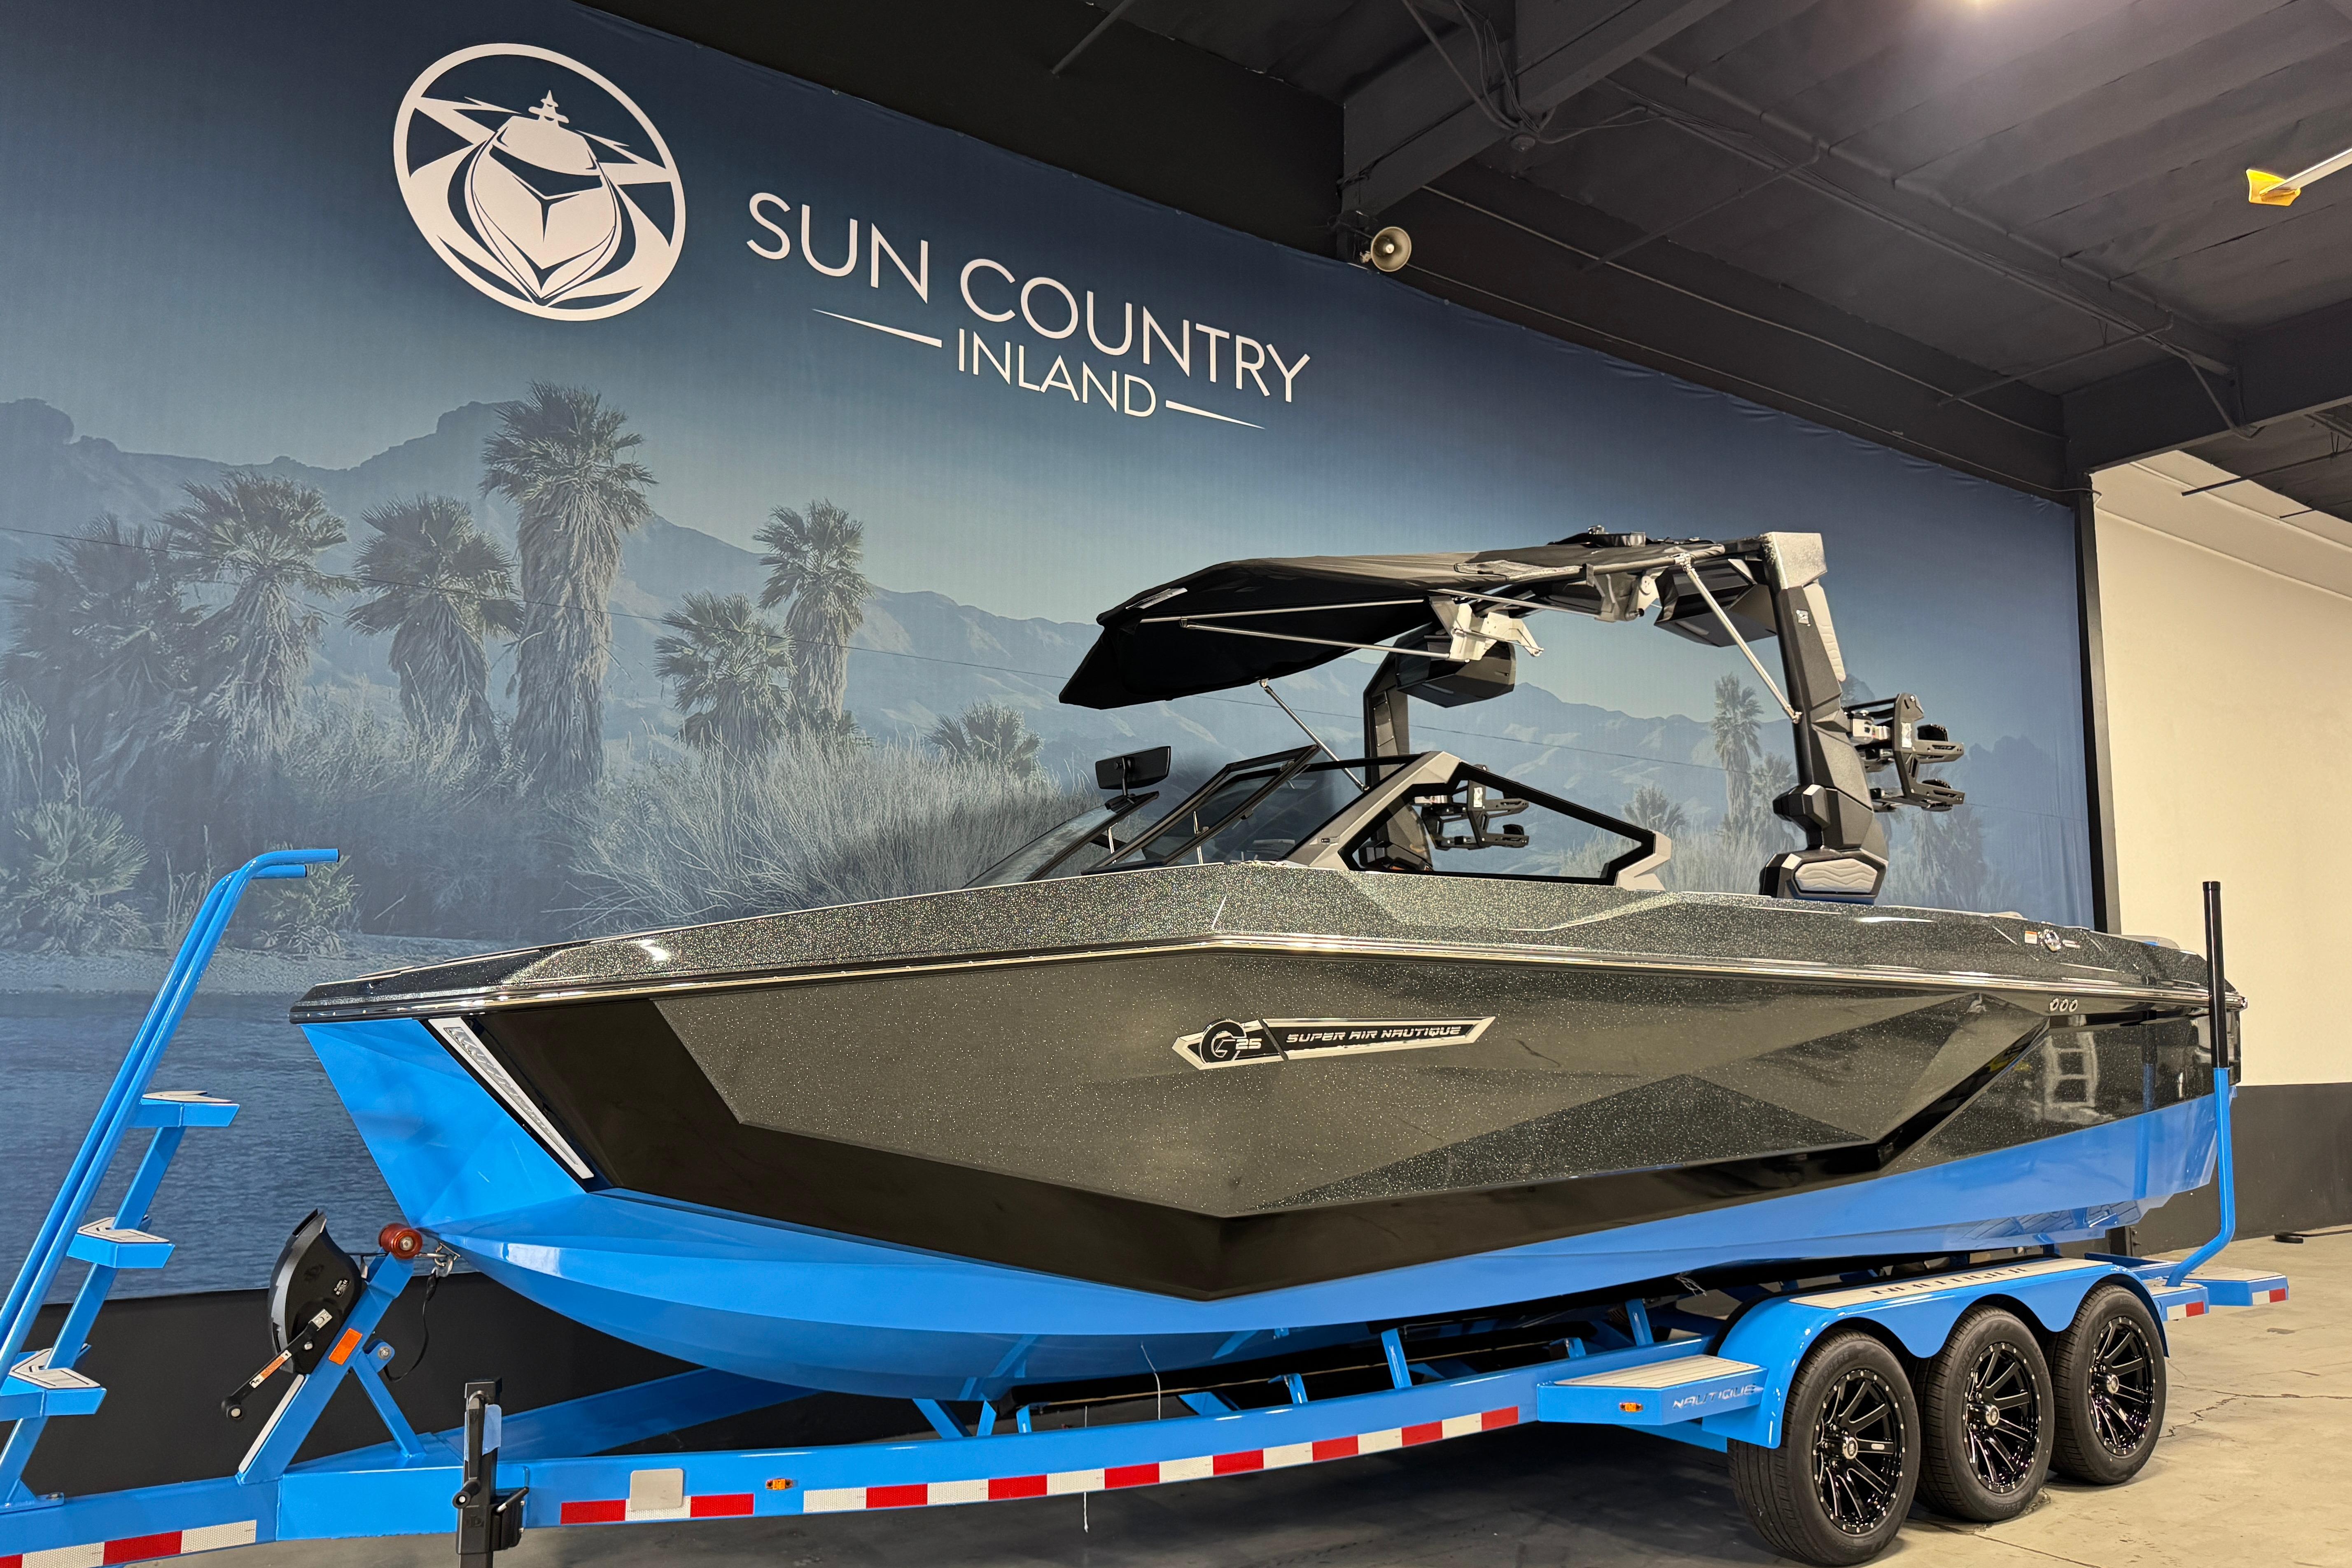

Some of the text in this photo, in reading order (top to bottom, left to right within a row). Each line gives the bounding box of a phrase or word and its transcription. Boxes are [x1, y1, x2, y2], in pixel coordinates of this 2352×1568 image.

[746, 192, 1311, 403] SUN COUNTRY
[958, 328, 1157, 418] INLAND
[1286, 1031, 1346, 1043] SUPER
[1349, 1030, 1378, 1040] AIR
[1380, 1026, 1461, 1038] NAUTIQUE
[1672, 1383, 1757, 1409] NAUTIQUE
